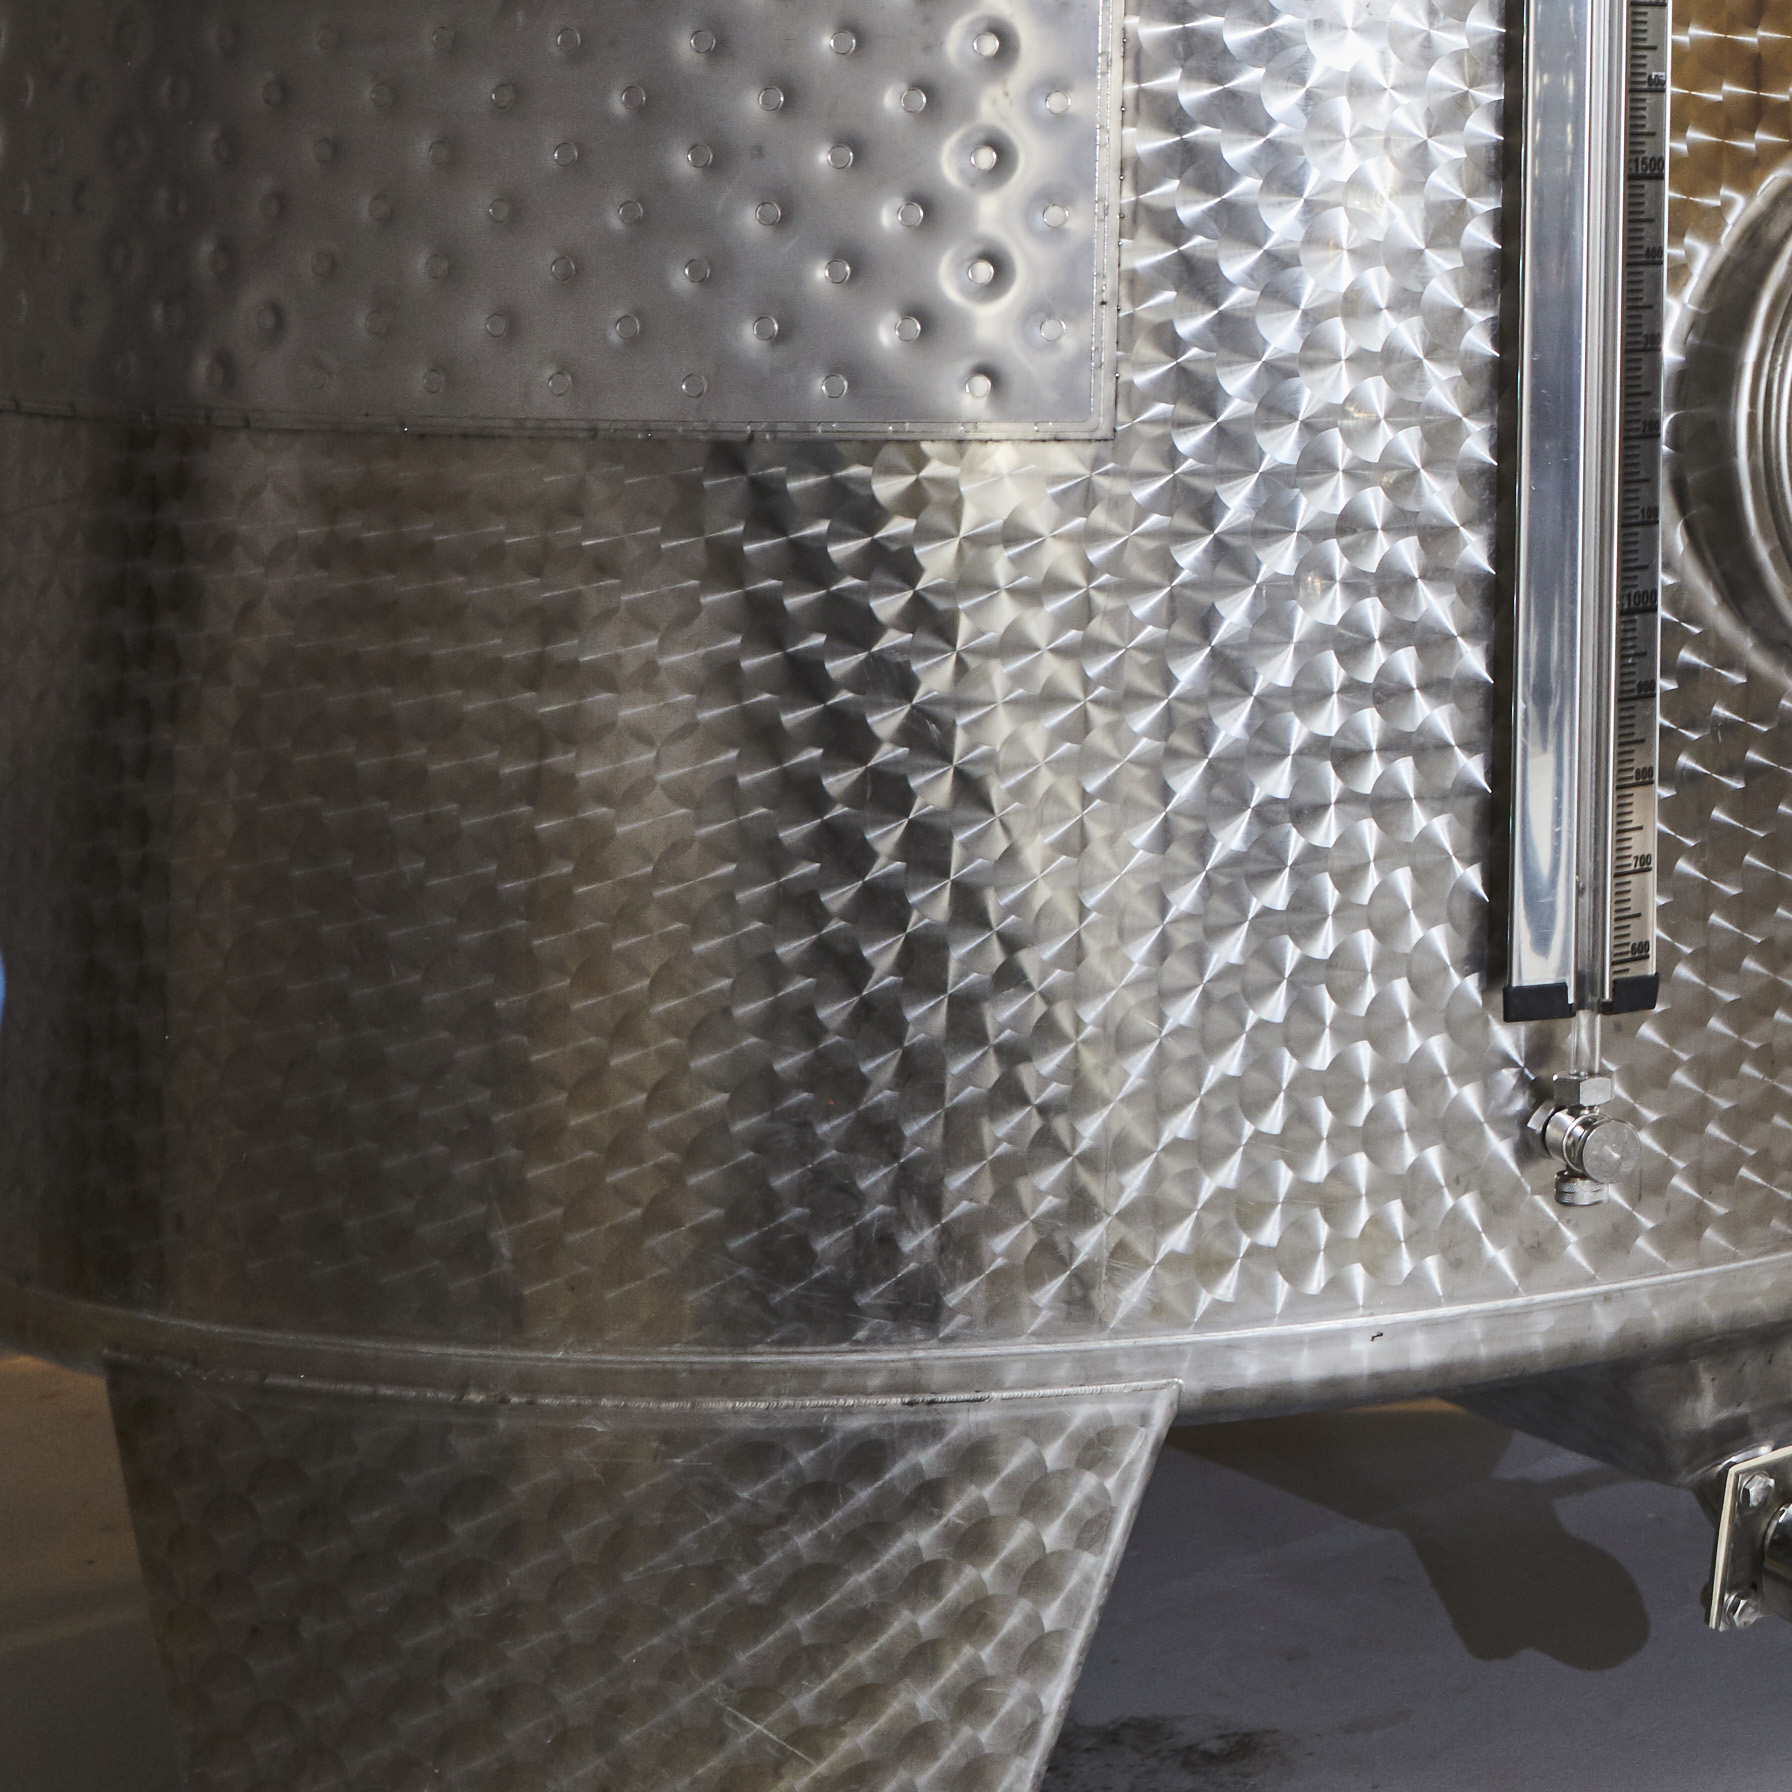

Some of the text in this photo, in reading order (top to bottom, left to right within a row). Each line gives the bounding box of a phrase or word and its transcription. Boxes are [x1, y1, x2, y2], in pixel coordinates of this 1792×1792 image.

[1633, 156, 1665, 172] 1500
[1644, 247, 1663, 260] 400
[1642, 420, 1660, 433] 200
[1640, 508, 1659, 520] 100
[1626, 590, 1658, 606] 1000
[1636, 679, 1656, 694] 900
[1634, 766, 1654, 781] 800
[1633, 853, 1652, 868] 700
[1630, 940, 1650, 956] 600
